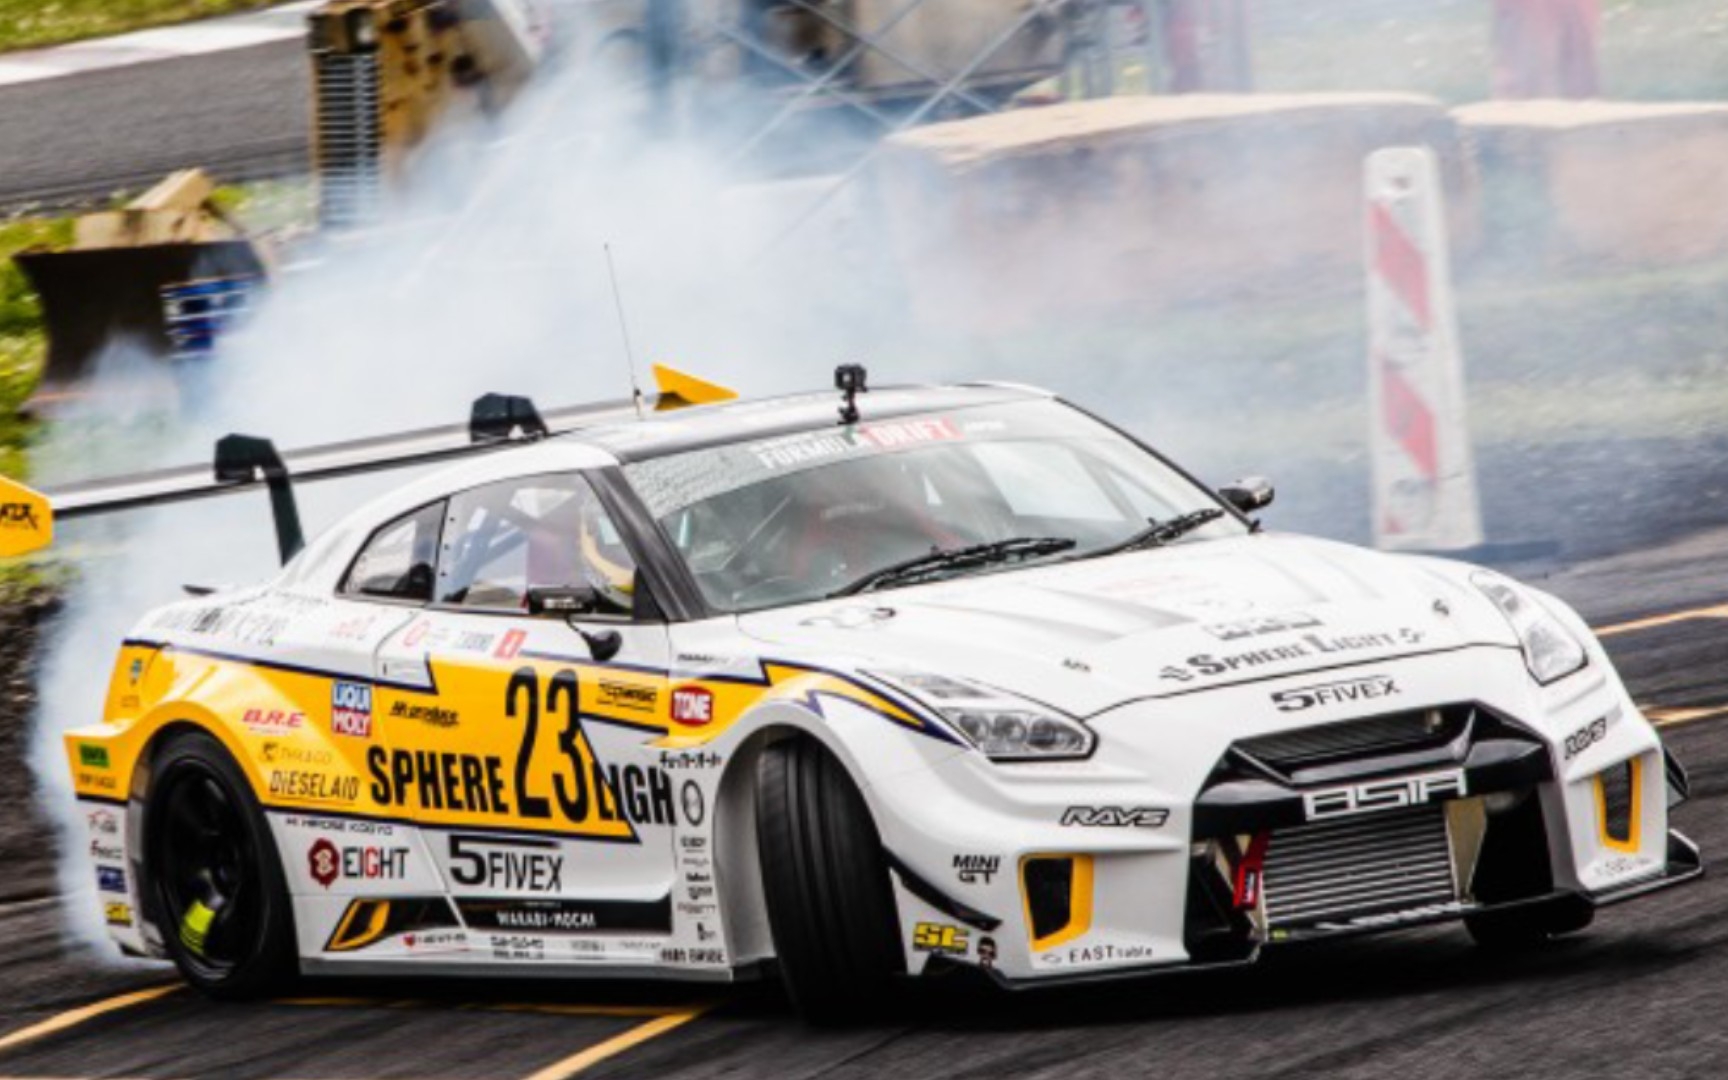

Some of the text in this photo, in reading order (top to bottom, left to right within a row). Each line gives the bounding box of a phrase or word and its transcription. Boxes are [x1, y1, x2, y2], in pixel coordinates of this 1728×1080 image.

[868, 414, 958, 448] DRIFT
[1186, 633, 1397, 676] SPHERE LIGHT
[332, 709, 371, 736] MOLY
[505, 666, 589, 822] 23
[366, 744, 510, 814] SPHERE
[1060, 806, 1169, 827] RAYS
[342, 847, 410, 880] EIGHT
[952, 854, 1000, 870] MINI
[957, 869, 993, 884] GT
